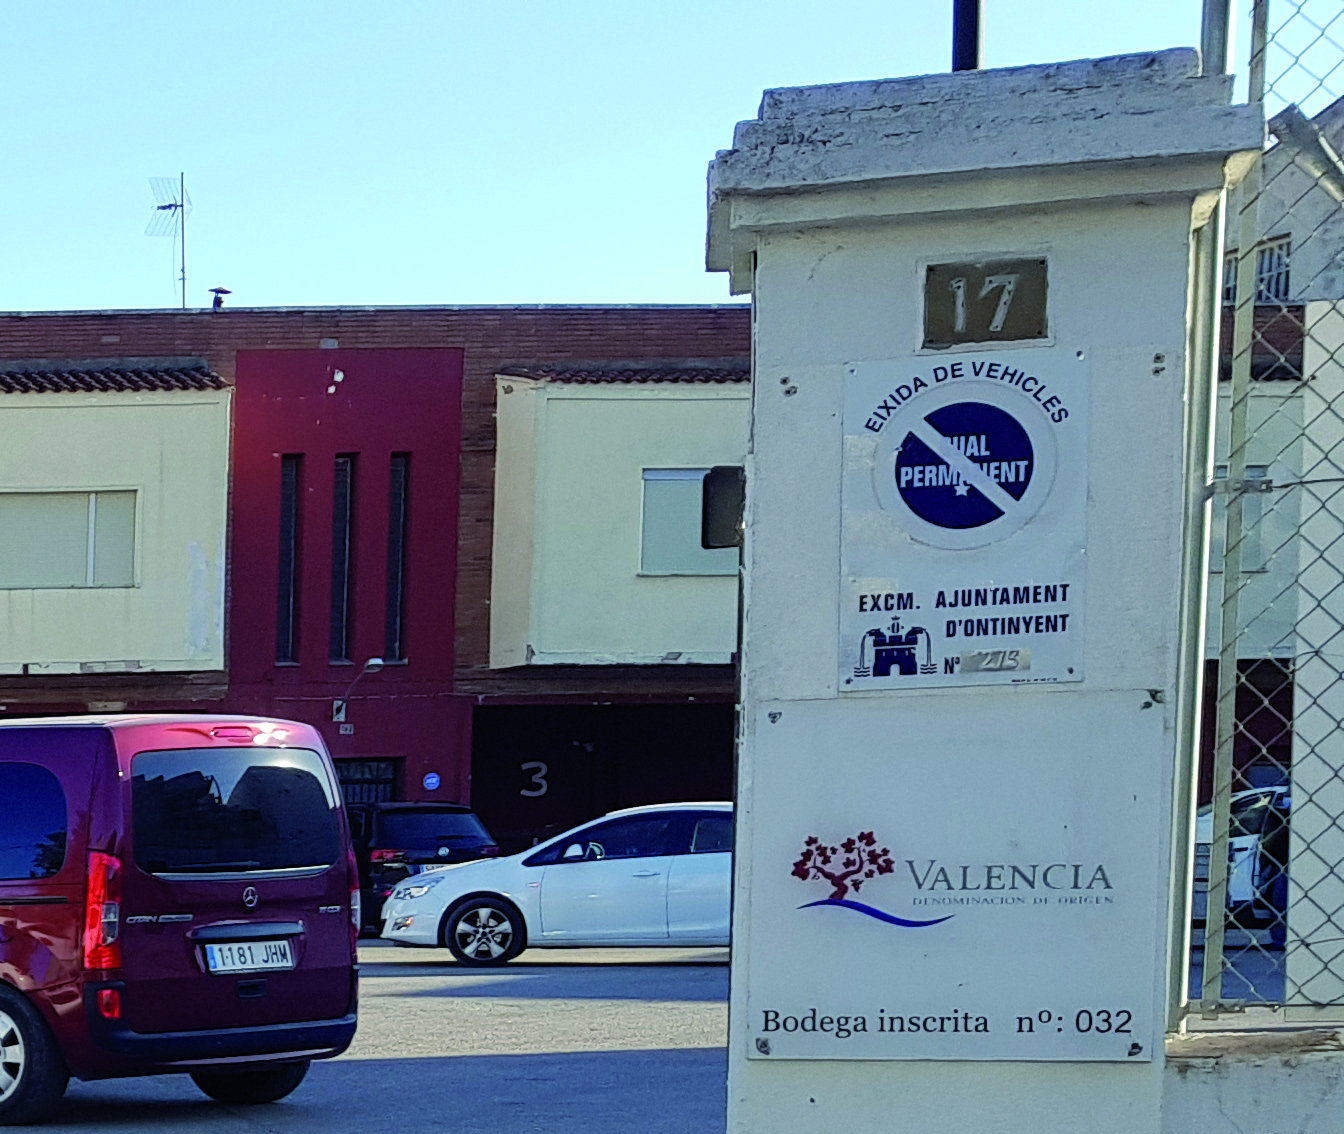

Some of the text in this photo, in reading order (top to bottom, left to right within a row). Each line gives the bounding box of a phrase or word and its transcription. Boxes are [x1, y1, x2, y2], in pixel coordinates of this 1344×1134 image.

[949, 273, 1020, 333] 17
[864, 361, 1069, 433] EIXIDA DE VEHICLES
[858, 583, 1070, 613] EXCM. AJUNTAMENT
[945, 613, 1070, 638] D'ONTINYENT
[519, 760, 549, 797] 3
[218, 943, 289, 967] 1181 JHM
[761, 1008, 868, 1039] Bodega
[878, 1008, 990, 1034] inscrita
[1075, 1009, 1133, 1035] 032
